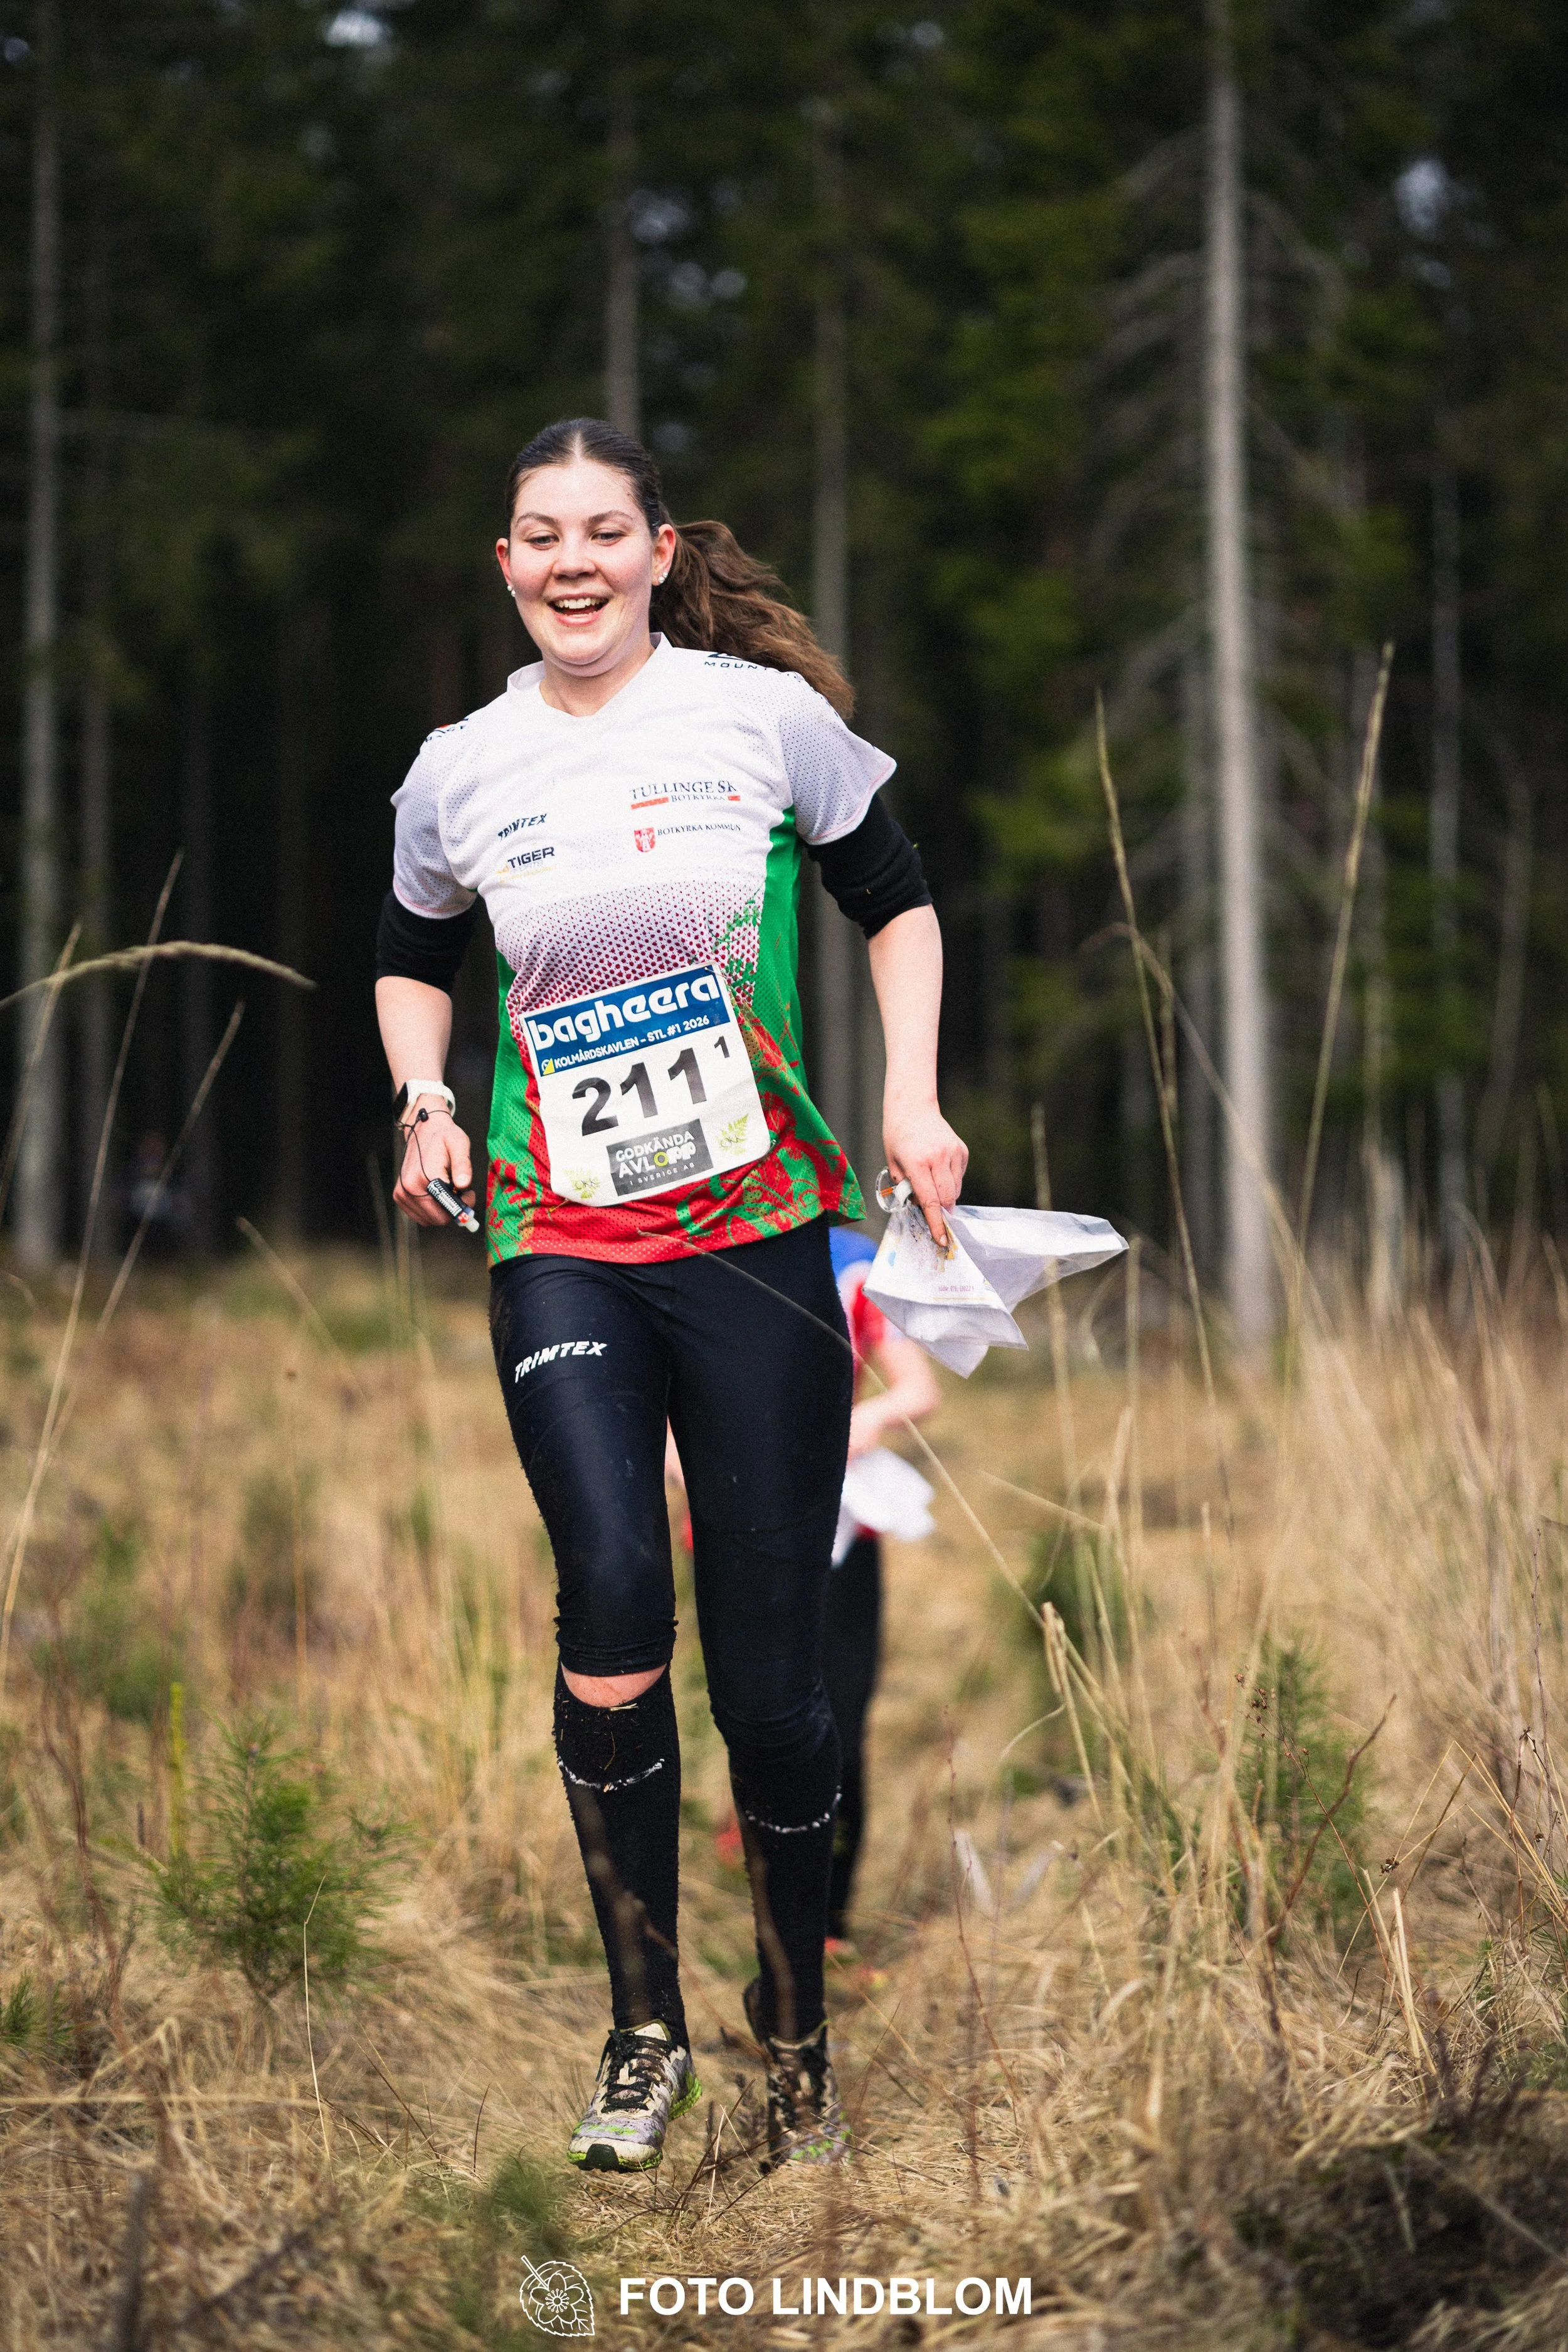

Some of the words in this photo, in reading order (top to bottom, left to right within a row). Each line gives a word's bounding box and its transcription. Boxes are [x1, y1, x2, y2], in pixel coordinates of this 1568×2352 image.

[629, 781, 714, 800] TULLINGE
[657, 824, 703, 836] BOTKYRKA
[706, 823, 741, 832] KOMMUN
[507, 846, 555, 869] TIGER
[528, 974, 721, 1051] bagheera
[554, 1036, 640, 1069] KOLMÅRDSKAVLEN
[647, 1030, 667, 1043] STL
[667, 1022, 682, 1037] #1
[682, 1015, 710, 1032] 2026
[714, 1036, 731, 1059] 1
[571, 1047, 707, 1136] 211
[615, 1131, 695, 1163] GODKÄNDA
[637, 1167, 679, 1184] SVERIGE
[683, 1162, 695, 1171] AB
[515, 1340, 608, 1384] TRIMTEX
